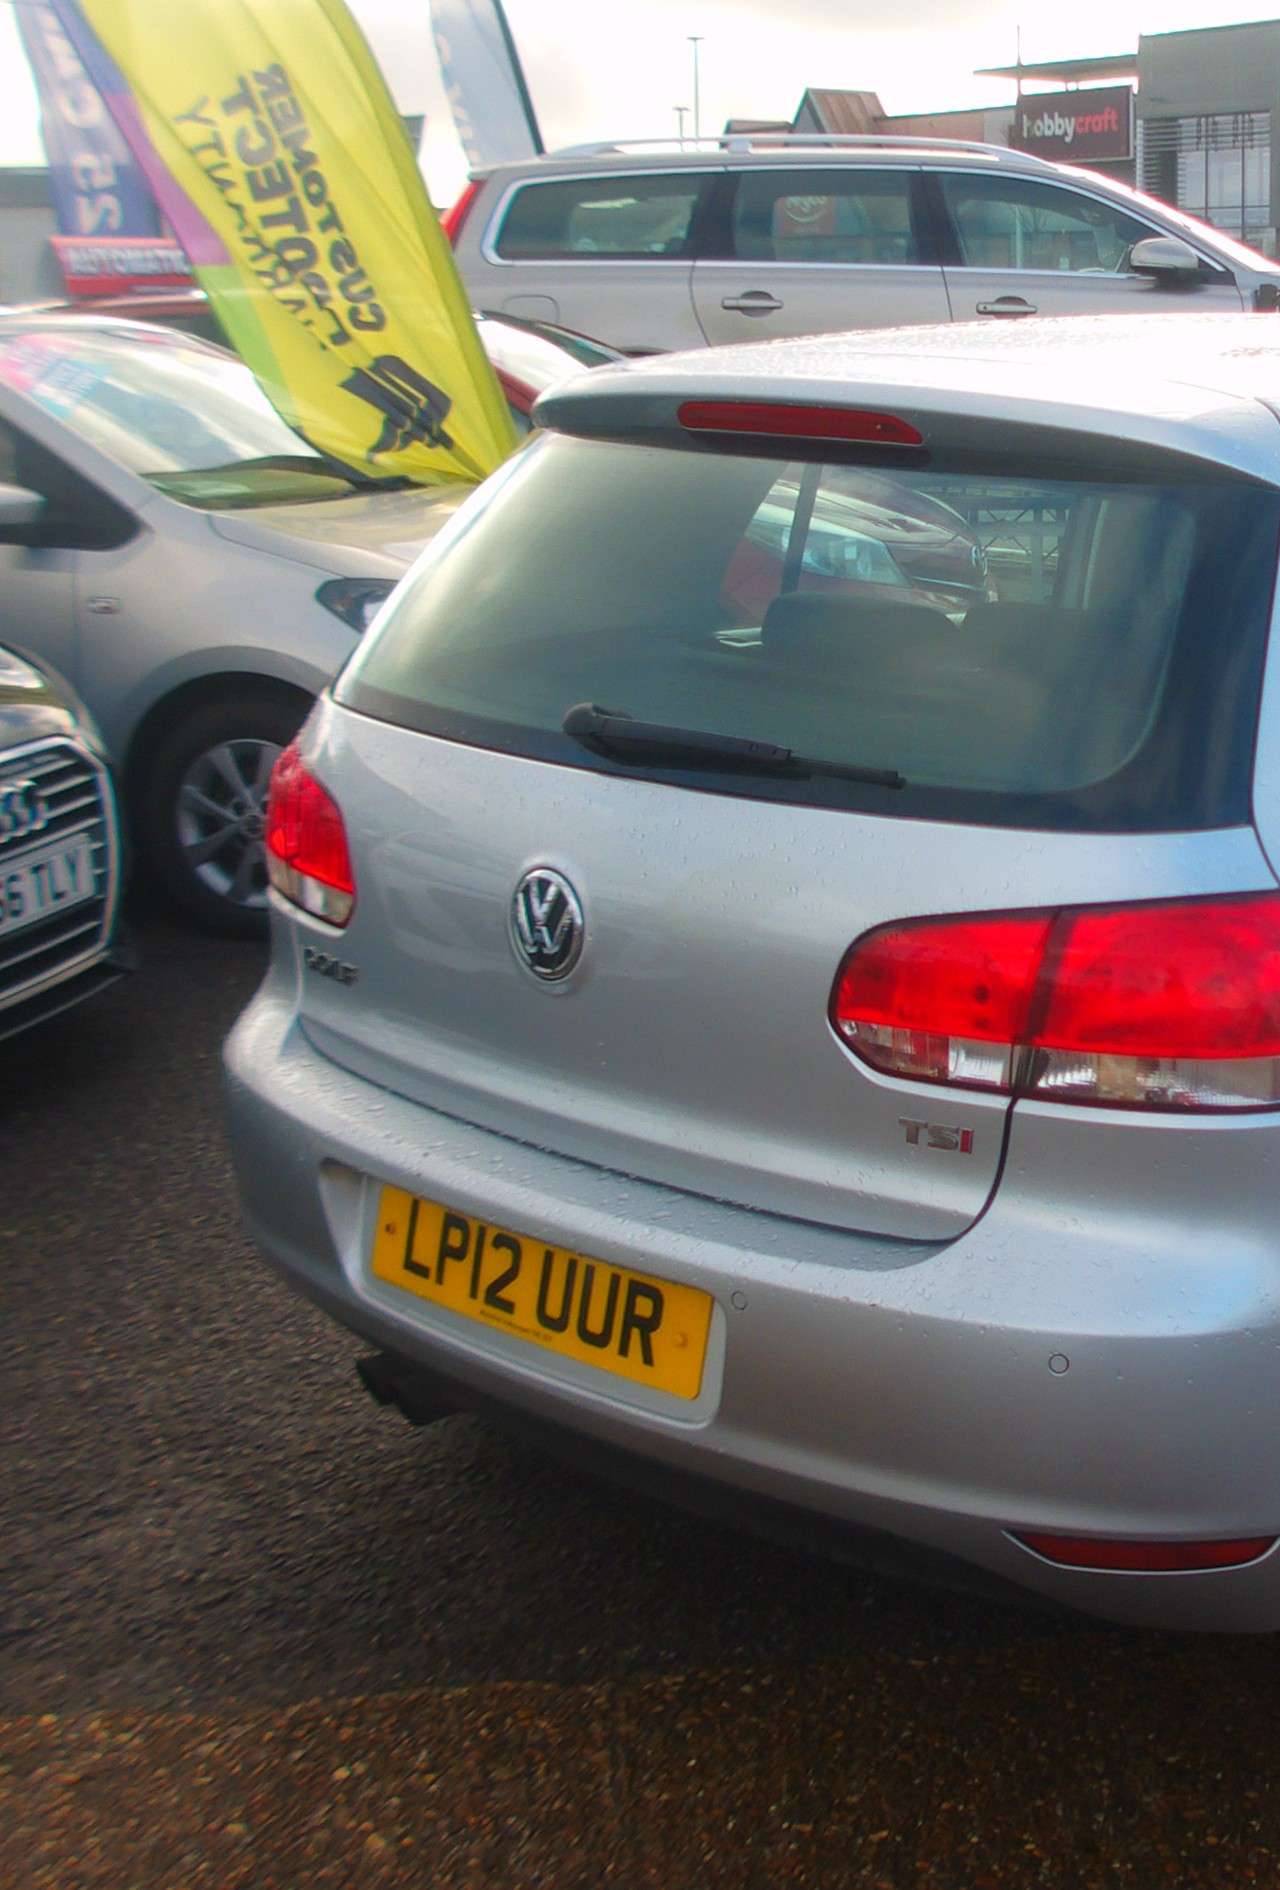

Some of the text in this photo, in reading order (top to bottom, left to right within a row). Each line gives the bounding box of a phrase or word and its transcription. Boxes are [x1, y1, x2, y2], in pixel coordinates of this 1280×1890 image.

[1023, 106, 1118, 142] hobbycraft
[403, 1198, 666, 1367] LP12 UUR
